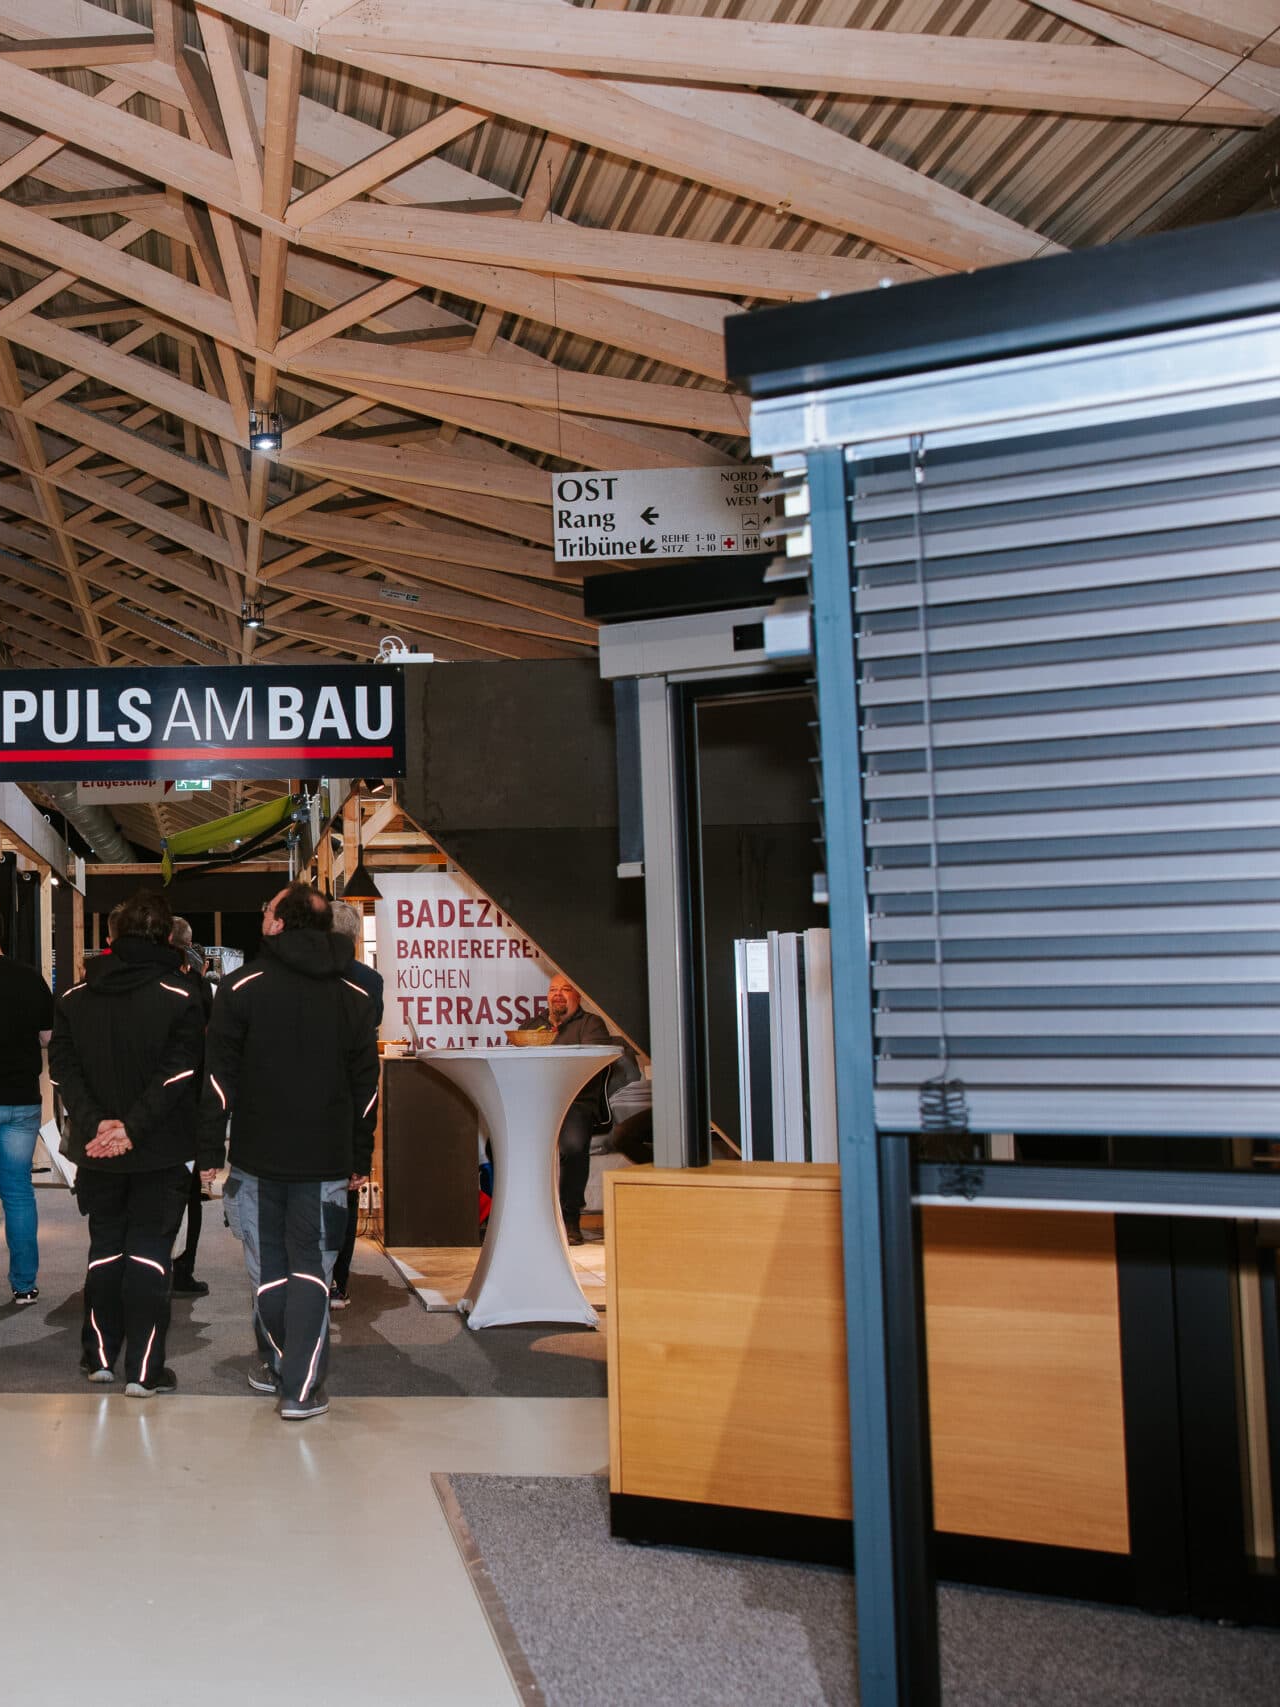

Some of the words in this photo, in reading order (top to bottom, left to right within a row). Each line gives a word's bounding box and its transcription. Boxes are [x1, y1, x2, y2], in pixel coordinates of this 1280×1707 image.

[721, 472, 758, 482] NORD
[557, 478, 618, 502] OST
[733, 481, 758, 494] SÜD
[726, 496, 758, 506] WEST
[558, 510, 616, 532] Rang
[558, 536, 637, 557] Tribüne
[661, 534, 690, 543] REIHE
[695, 533, 716, 542] 1-10
[661, 544, 684, 553] SITZ
[695, 543, 716, 552] 1-10
[397, 899, 512, 928] BADEZI
[397, 966, 470, 989] KÜCHEN
